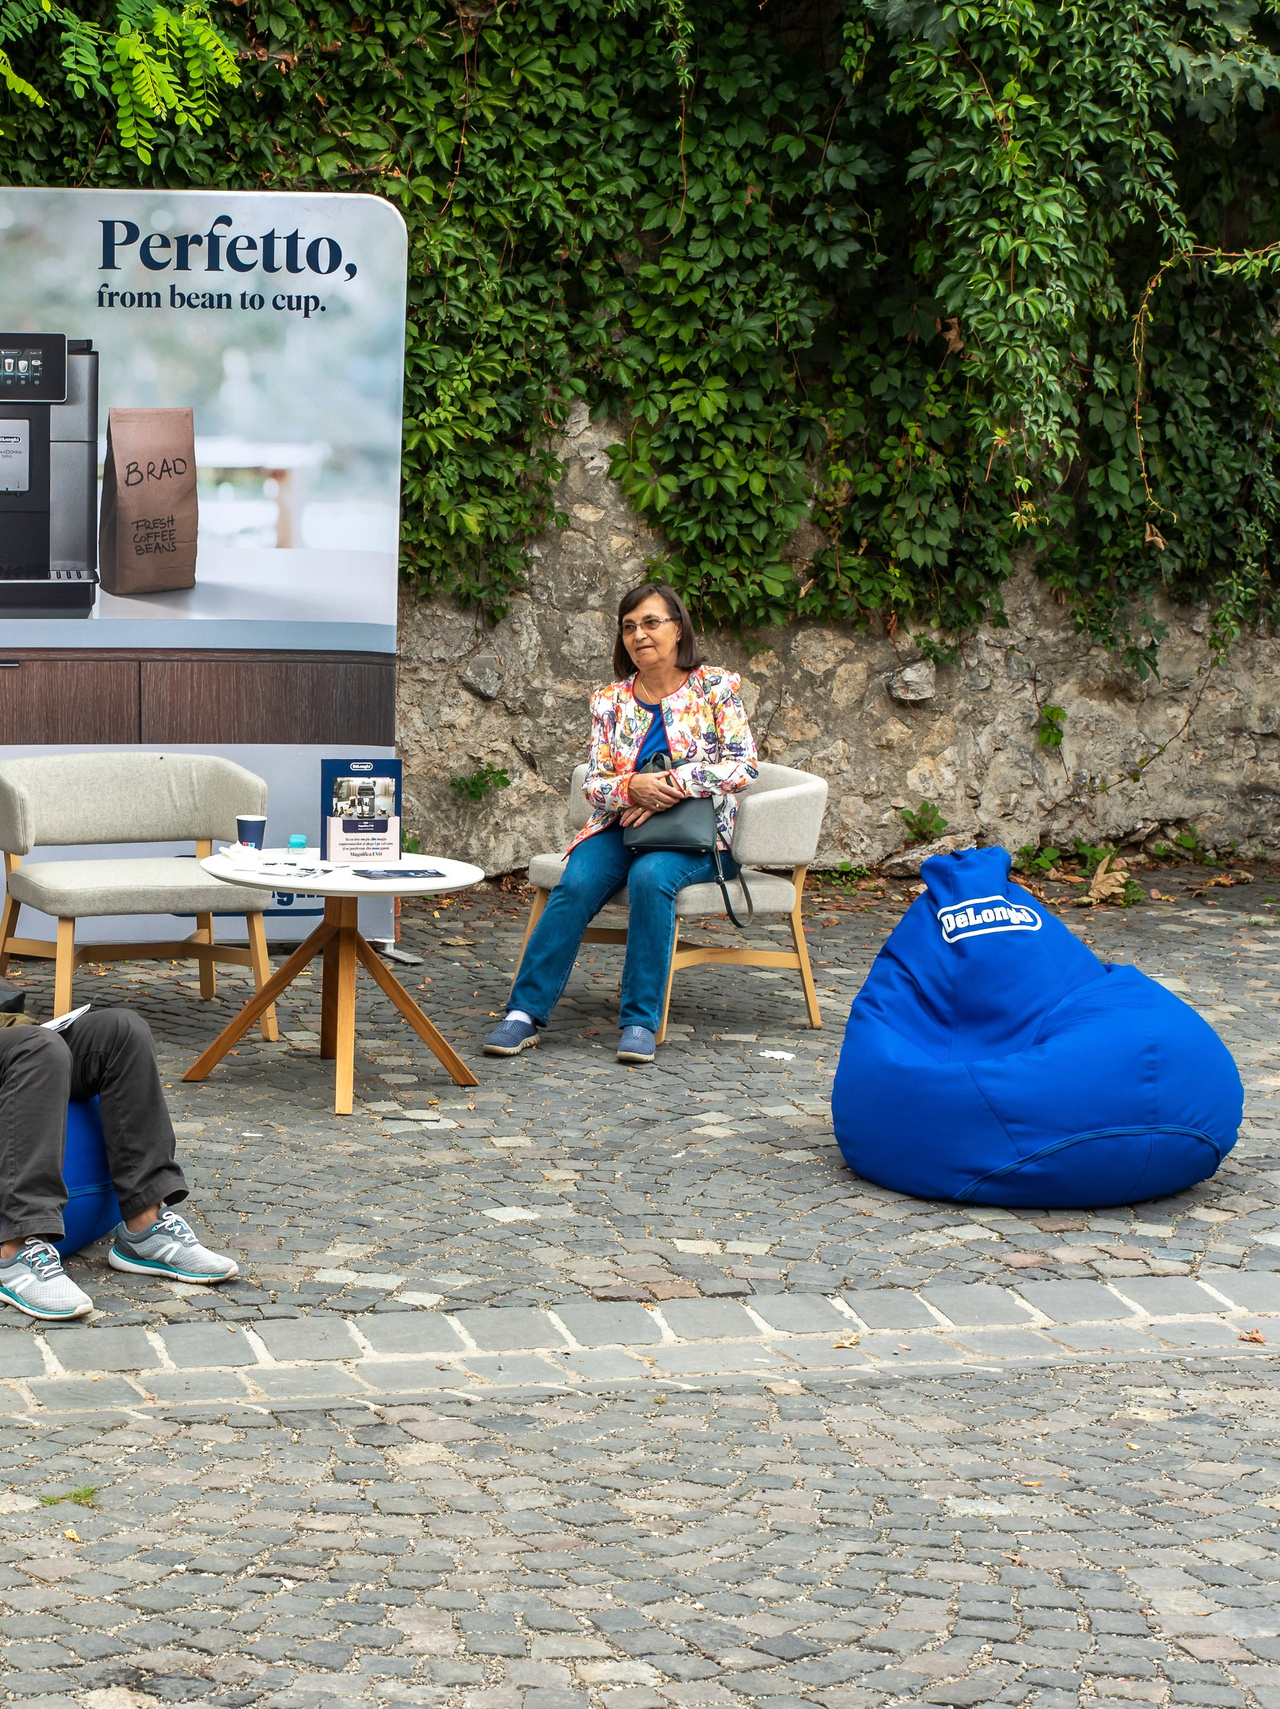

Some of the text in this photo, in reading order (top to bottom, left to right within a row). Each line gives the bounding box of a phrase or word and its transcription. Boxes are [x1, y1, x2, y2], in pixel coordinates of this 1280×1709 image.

[98, 215, 358, 282] Perfetto,
[97, 283, 327, 318] from bean to cup.
[124, 458, 188, 487] BRAD
[131, 515, 175, 531] FRESH
[133, 529, 176, 543] COFFEE
[134, 542, 177, 556] BEANS
